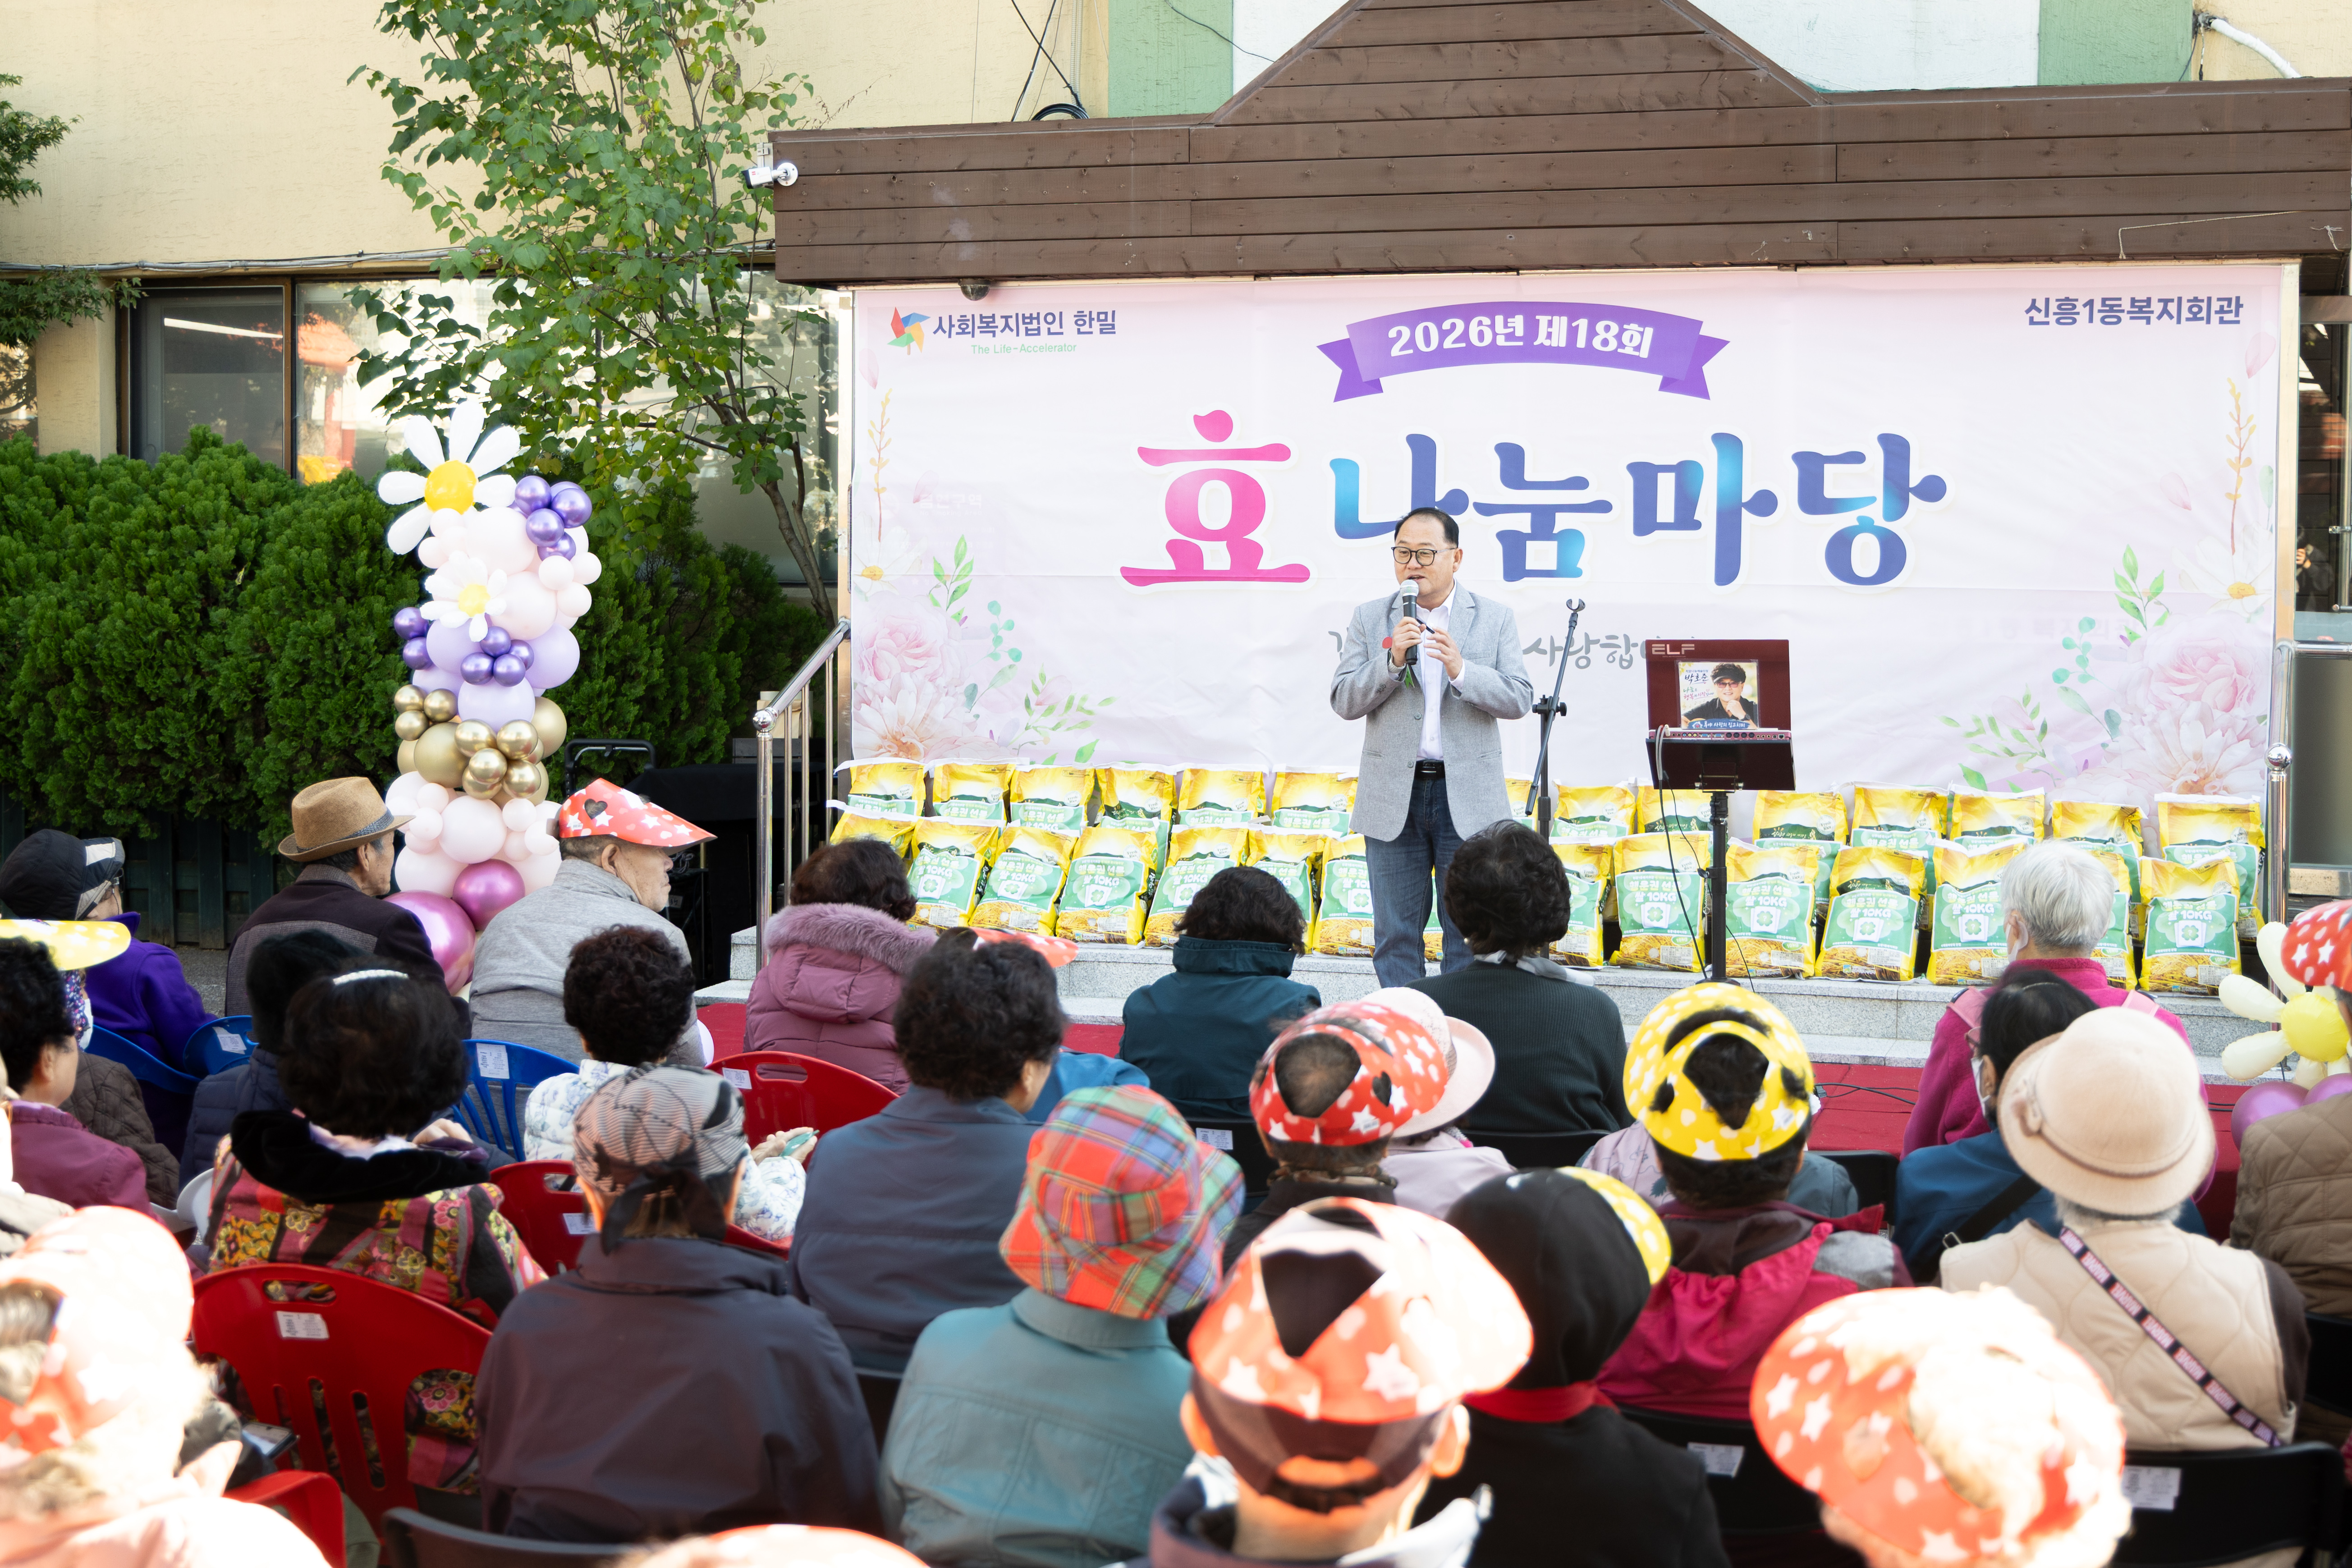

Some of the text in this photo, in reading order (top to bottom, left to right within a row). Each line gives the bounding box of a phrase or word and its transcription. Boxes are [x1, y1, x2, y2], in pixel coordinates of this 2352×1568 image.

[2025, 296, 2244, 326] 신흥1동복지회관
[933, 310, 1116, 339] 사회복지법인 한밀
[1387, 314, 1653, 359] 2026년 제18회
[972, 343, 1077, 354] The Life-Accelerator
[1522, 632, 1646, 669] 사랑합
[1652, 644, 1695, 655] ELF
[1685, 673, 1709, 685] 박호준
[1284, 817, 1330, 829] 행운권 선물
[926, 865, 953, 877] 10KG
[998, 860, 1044, 875] 행운권 선물
[1078, 864, 1125, 876] 행운권 선물
[1172, 864, 1215, 876] 행운권 선물
[1338, 867, 1367, 879] 행운권
[999, 870, 1036, 882] 쌀 10KG
[1083, 875, 1120, 886] 쌀 10KG
[1173, 874, 1209, 885] 쌀 10KG
[1342, 878, 1370, 889] 쌀 10
[1629, 880, 1660, 891] 행운권
[1635, 891, 1677, 902] 쌀 10KG
[1742, 885, 1793, 897] 행운권 선물
[1977, 891, 1999, 903] 선물
[1746, 895, 1787, 907] 쌀 10KG
[1846, 897, 1898, 909] 행운권 선물
[1850, 908, 1891, 918] 쌀 10KG
[1952, 903, 1994, 915] 쌀 10KG
[2168, 910, 2212, 921] 쌀 10KG
